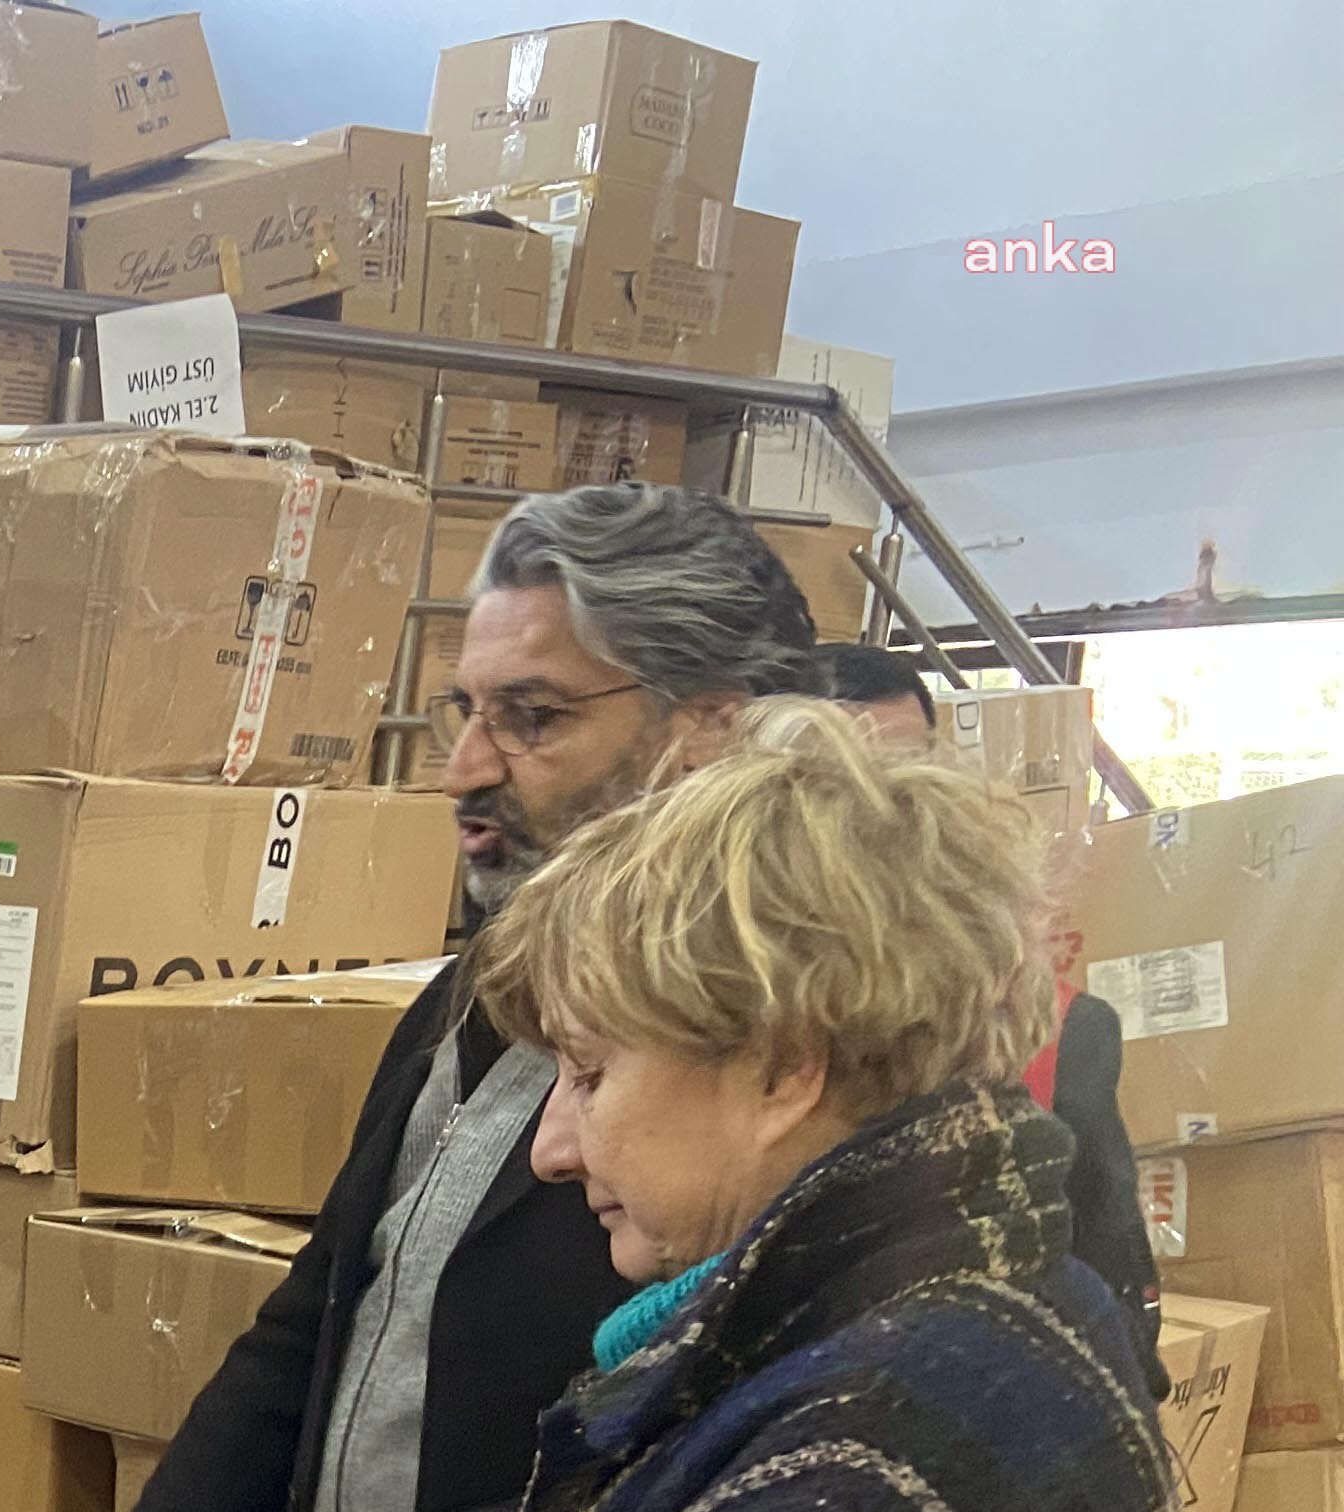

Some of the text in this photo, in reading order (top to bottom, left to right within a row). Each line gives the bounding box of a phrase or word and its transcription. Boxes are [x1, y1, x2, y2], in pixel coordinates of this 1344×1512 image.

[127, 357, 215, 395] ÜST GİYİM
[183, 393, 219, 420] 2.EL
